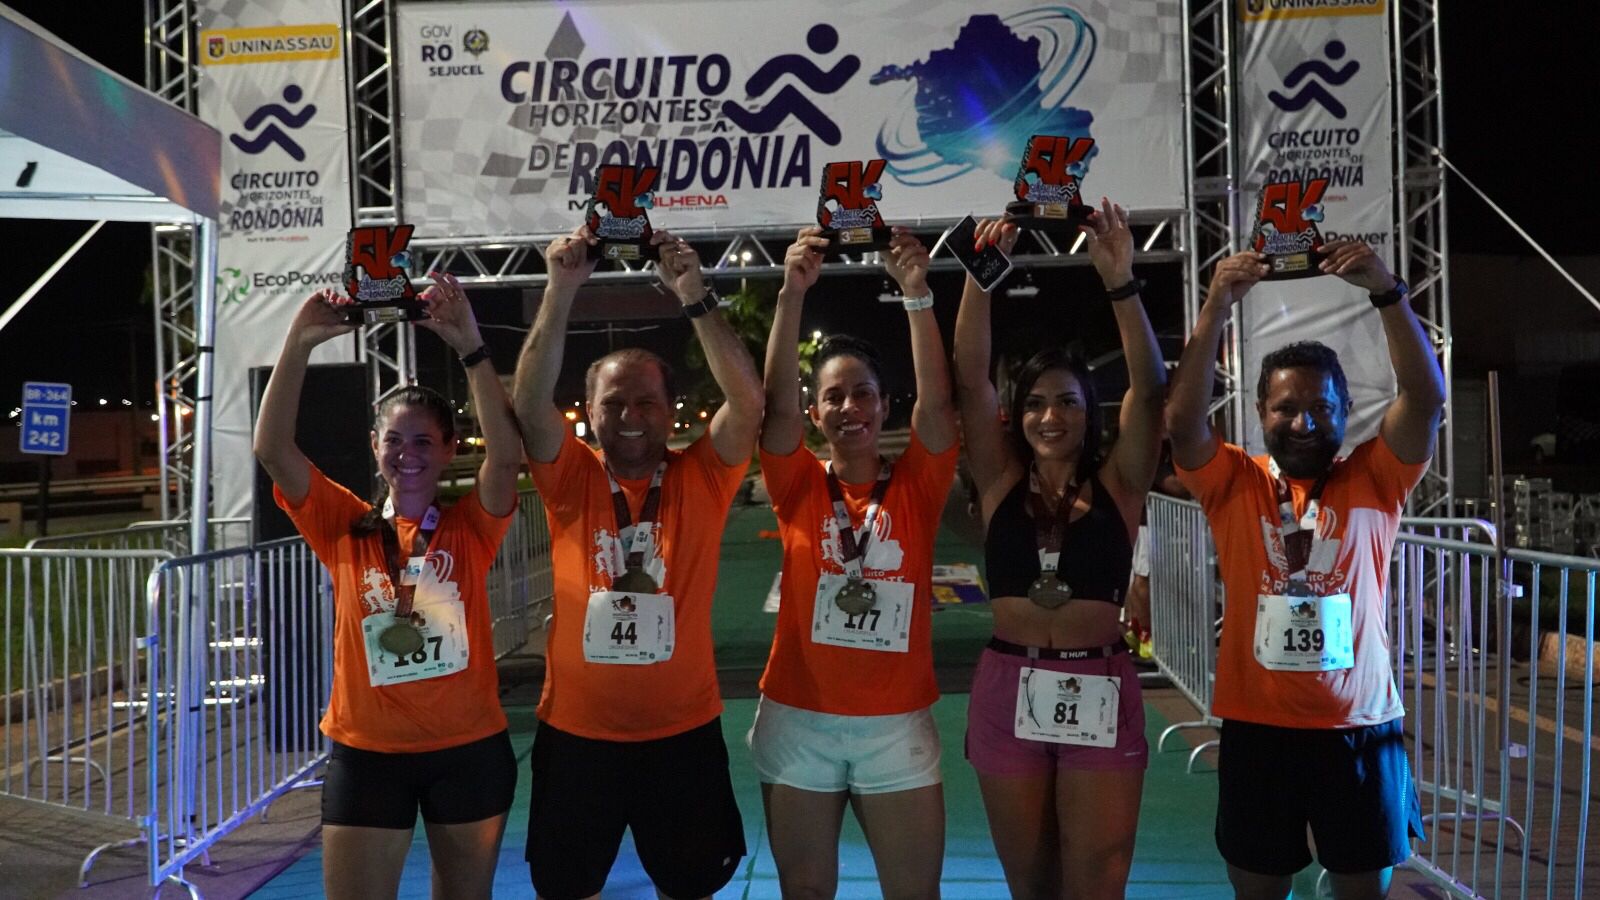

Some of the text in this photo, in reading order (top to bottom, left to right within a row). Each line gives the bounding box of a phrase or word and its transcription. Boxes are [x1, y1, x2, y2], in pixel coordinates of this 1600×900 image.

[420, 24, 452, 39] GOV
[229, 36, 333, 54] UNINASSAU
[421, 45, 453, 63] RO
[429, 64, 485, 77] SEJUCEL
[501, 54, 731, 104] CIRCUITO
[529, 98, 712, 128] HORIZONTES
[1268, 128, 1361, 149] CIRCUITO
[528, 143, 569, 173] DE
[1026, 135, 1095, 185] 5K
[1277, 149, 1351, 161] HORIZONTES
[231, 170, 319, 190] CIRCUITO
[825, 158, 887, 210] 5K
[239, 190, 312, 202] HORIZONTES
[596, 164, 659, 218] 5K
[653, 194, 728, 208] ILHENA
[1260, 178, 1329, 234] 5K
[1325, 231, 1389, 246] Power
[352, 224, 415, 281] 5K
[32, 411, 59, 427] km
[28, 429, 60, 447] 242
[610, 621, 638, 645] 44
[1283, 627, 1325, 652] 139
[1053, 701, 1079, 725] 81
